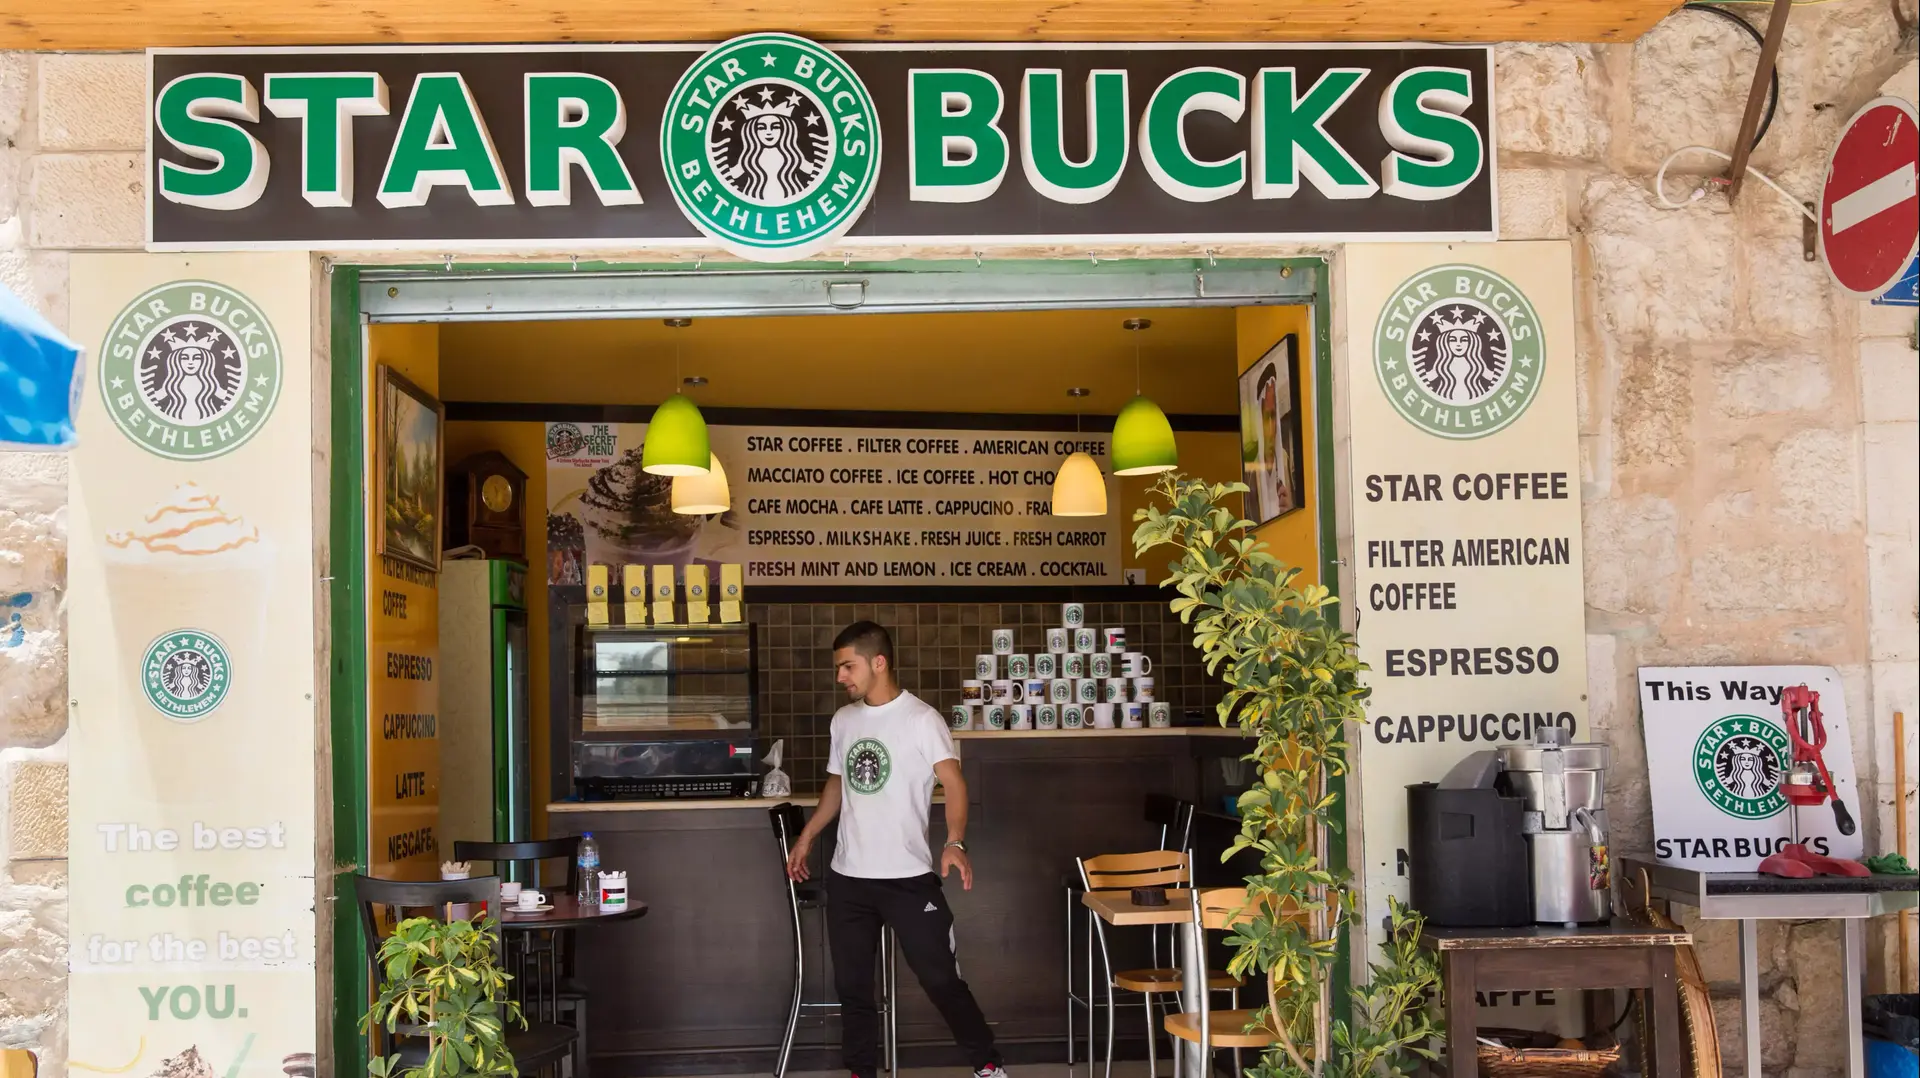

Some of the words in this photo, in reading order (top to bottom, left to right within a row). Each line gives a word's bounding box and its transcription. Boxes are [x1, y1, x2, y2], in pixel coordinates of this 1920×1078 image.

[681, 57, 748, 133] STAR
[794, 54, 866, 157] BUCKS
[155, 72, 643, 209] STAR
[908, 66, 1484, 204] BUCKS
[681, 158, 856, 235] BETHLEHEM
[1386, 281, 1438, 342] STAR
[1455, 276, 1531, 341] BUCKS
[113, 298, 171, 360] STAR
[189, 292, 269, 359] BUCKS
[1391, 371, 1529, 428] BETHLEHEM
[117, 390, 264, 448] BETHLEHEM
[592, 425, 608, 435] THE
[584, 435, 617, 446] SECRET
[588, 445, 613, 455] MENU
[747, 436, 783, 453] STAR
[788, 437, 843, 453] COFFEE
[857, 437, 902, 454] FILTER
[906, 438, 960, 454] COFFEE
[973, 439, 1049, 455] AMERICAN
[1054, 440, 1106, 456] COFFEE
[747, 467, 825, 484] MACCIATO
[829, 468, 884, 484] COFFEE
[896, 469, 919, 485] ICE
[922, 469, 976, 485] COFFEE
[988, 470, 1019, 486] HOT
[1365, 474, 1443, 503] STAR
[1451, 472, 1569, 502] COFFEE
[747, 498, 782, 515] CAFE
[785, 498, 839, 515] MOCHA
[850, 499, 884, 515] CAFE
[887, 499, 924, 516] LATTE
[935, 500, 1014, 516] CAPPUCINO
[747, 530, 815, 546] ESPRESSO
[826, 530, 911, 546] MILKSHAKE
[920, 530, 961, 547] FRESH
[964, 531, 1001, 547] JUICE
[1013, 530, 1052, 547] FRESH
[1056, 530, 1107, 547] CARROT
[1367, 539, 1445, 568] FILTER
[1451, 537, 1570, 566] AMERICAN
[748, 561, 796, 577] FRESH
[800, 561, 841, 577] MINT
[844, 561, 879, 577] AND
[883, 561, 936, 577] LEMON
[950, 561, 973, 577] ICE
[976, 561, 1027, 577] CREAM
[1039, 561, 1108, 577] COCKTAIL
[383, 589, 407, 619] COFFEE
[1369, 582, 1457, 611] COFFEE
[148, 640, 177, 679] STAR
[194, 638, 224, 681] BUCKS
[387, 652, 432, 681] ESPRESSO
[1386, 645, 1560, 677] ESPRESSO
[155, 689, 217, 713] BETHLEHEM
[1645, 680, 1712, 702] This
[1720, 680, 1784, 706] Way
[383, 713, 436, 740] CAPPUCCINO
[848, 743, 864, 765] STAR
[866, 742, 888, 765] BUCKS
[1699, 725, 1729, 769] STAR
[395, 771, 425, 799] LATTE
[1704, 778, 1787, 814] BETHLEHE
[97, 823, 180, 852] The
[192, 821, 286, 850] best
[124, 874, 261, 908] coffee
[87, 934, 139, 964] for
[149, 932, 207, 962] the
[217, 931, 297, 960] best
[138, 984, 249, 1021] YOU.
